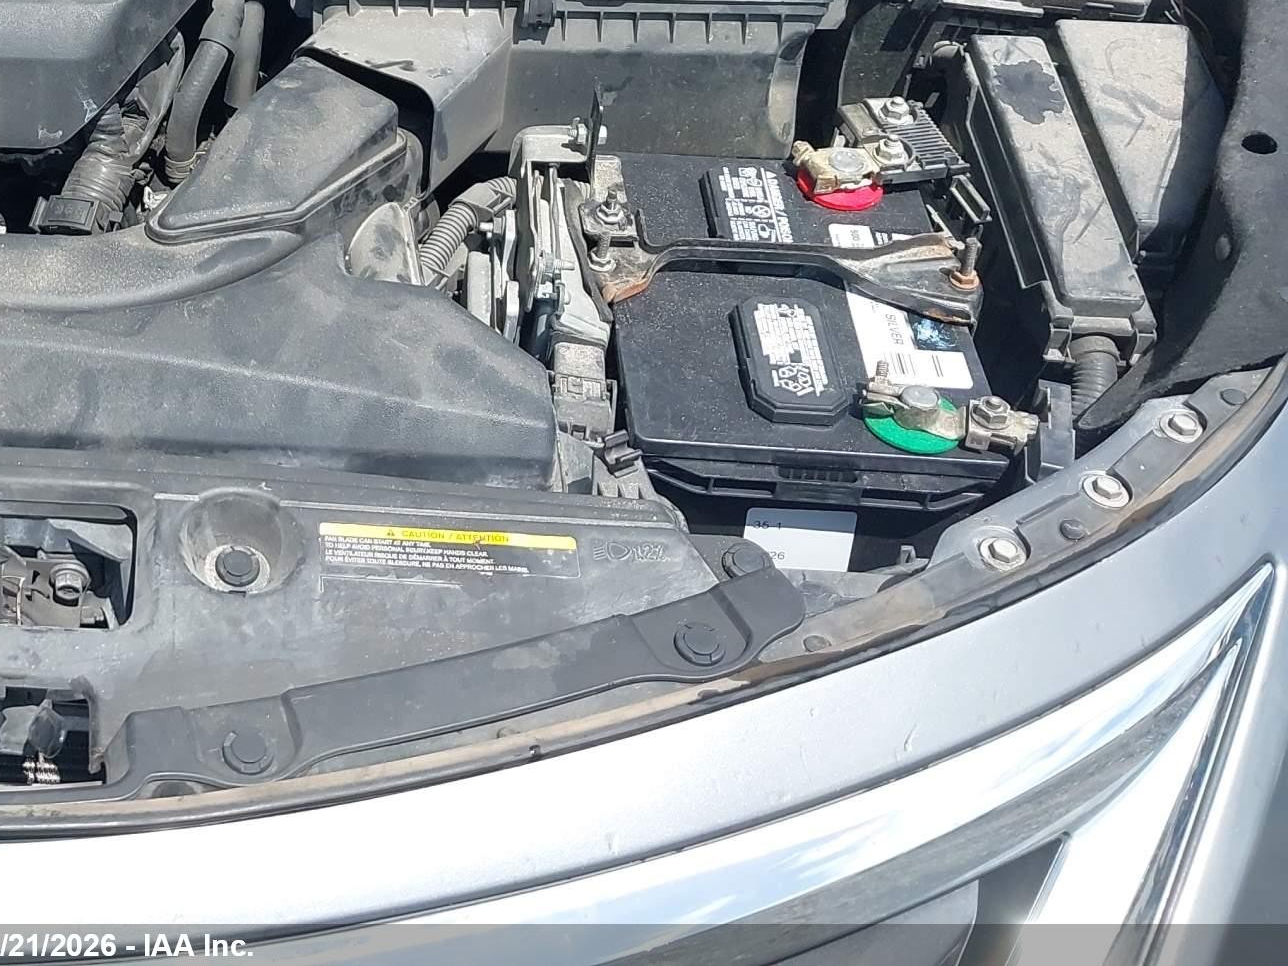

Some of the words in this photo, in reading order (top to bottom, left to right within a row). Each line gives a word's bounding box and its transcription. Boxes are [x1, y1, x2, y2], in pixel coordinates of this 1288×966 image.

[885, 313, 905, 345] SILVER
[401, 530, 444, 539] CAUTION
[456, 533, 509, 543] ATTENTION
[769, 550, 785, 560] 26
